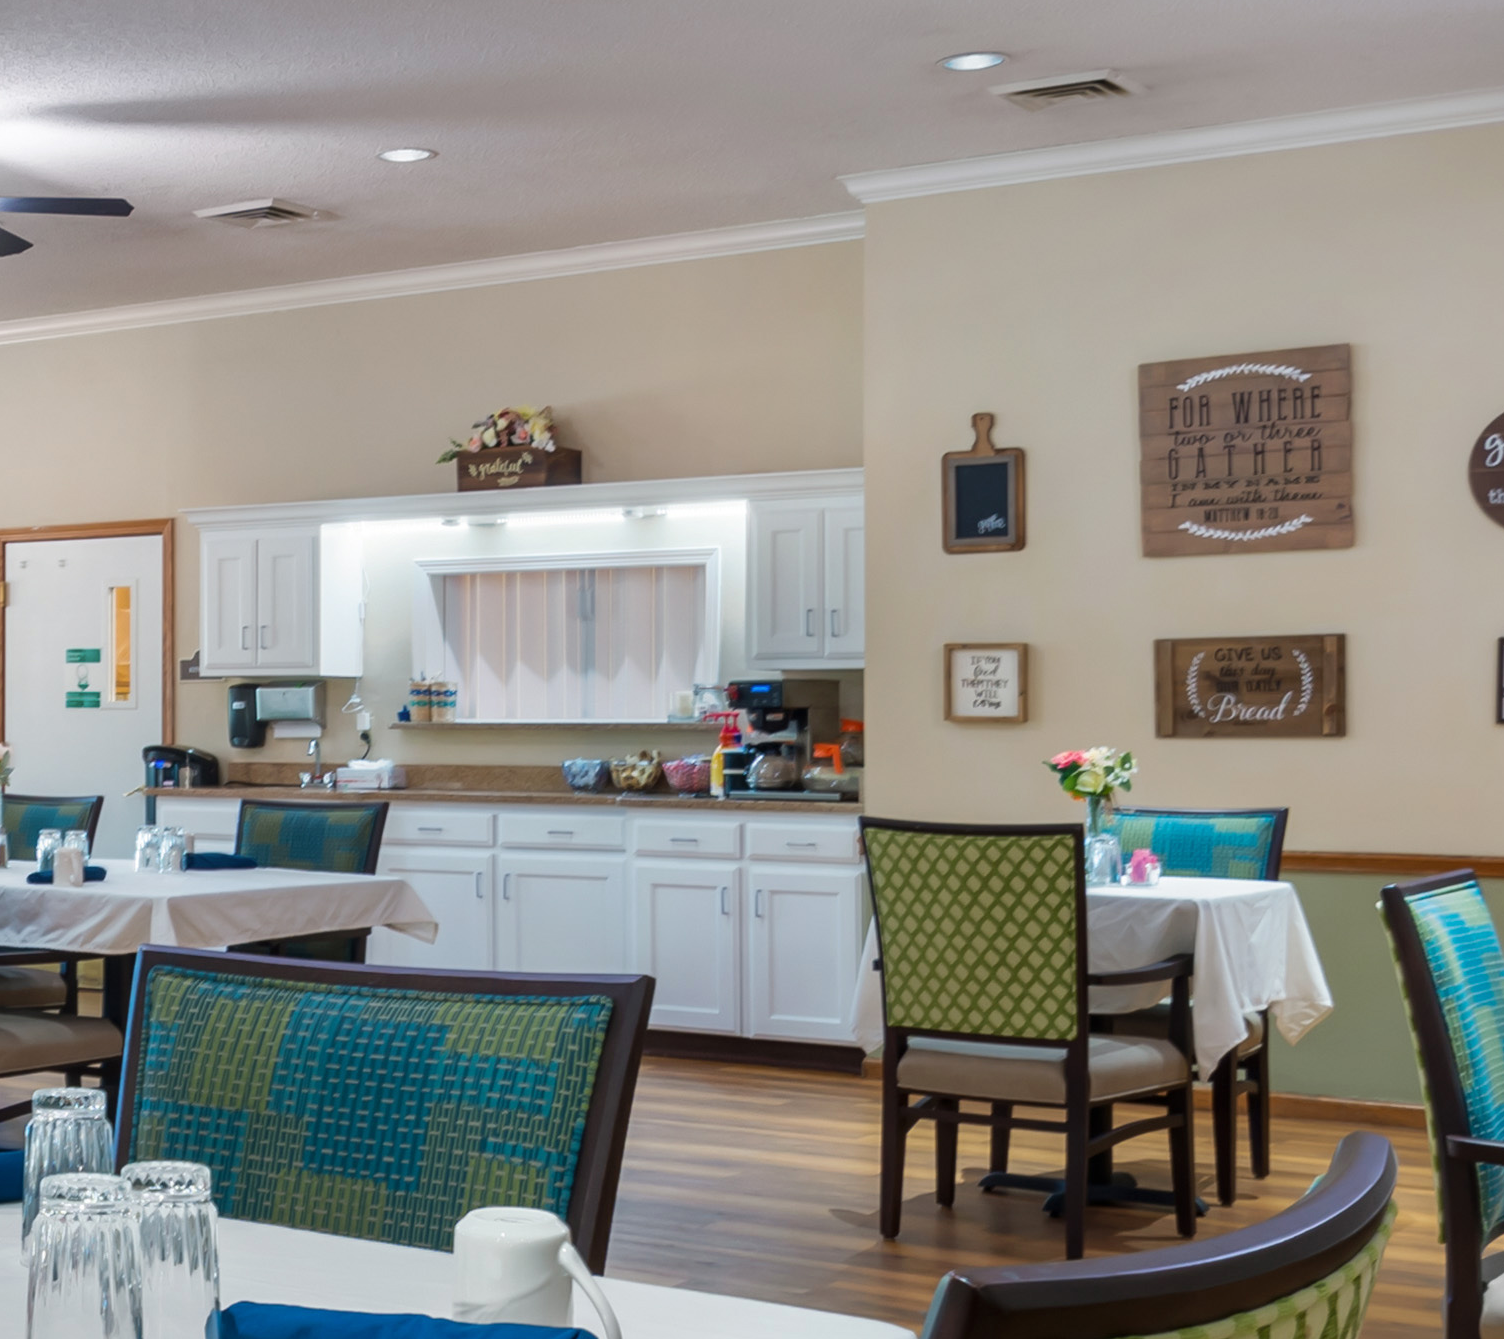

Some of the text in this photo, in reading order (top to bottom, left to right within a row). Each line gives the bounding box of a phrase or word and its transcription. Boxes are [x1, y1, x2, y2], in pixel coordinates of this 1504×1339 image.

[1168, 385, 1322, 429] FOR WHERE
[1168, 422, 1322, 446] two or three
[1167, 439, 1322, 480] GATHER
[1170, 493, 1181, 508] I
[1226, 488, 1267, 504] with
[1272, 487, 1323, 501] them
[1204, 507, 1250, 523] MATTHEW
[1214, 646, 1283, 662] GIVE US
[1207, 690, 1293, 724] Bread
